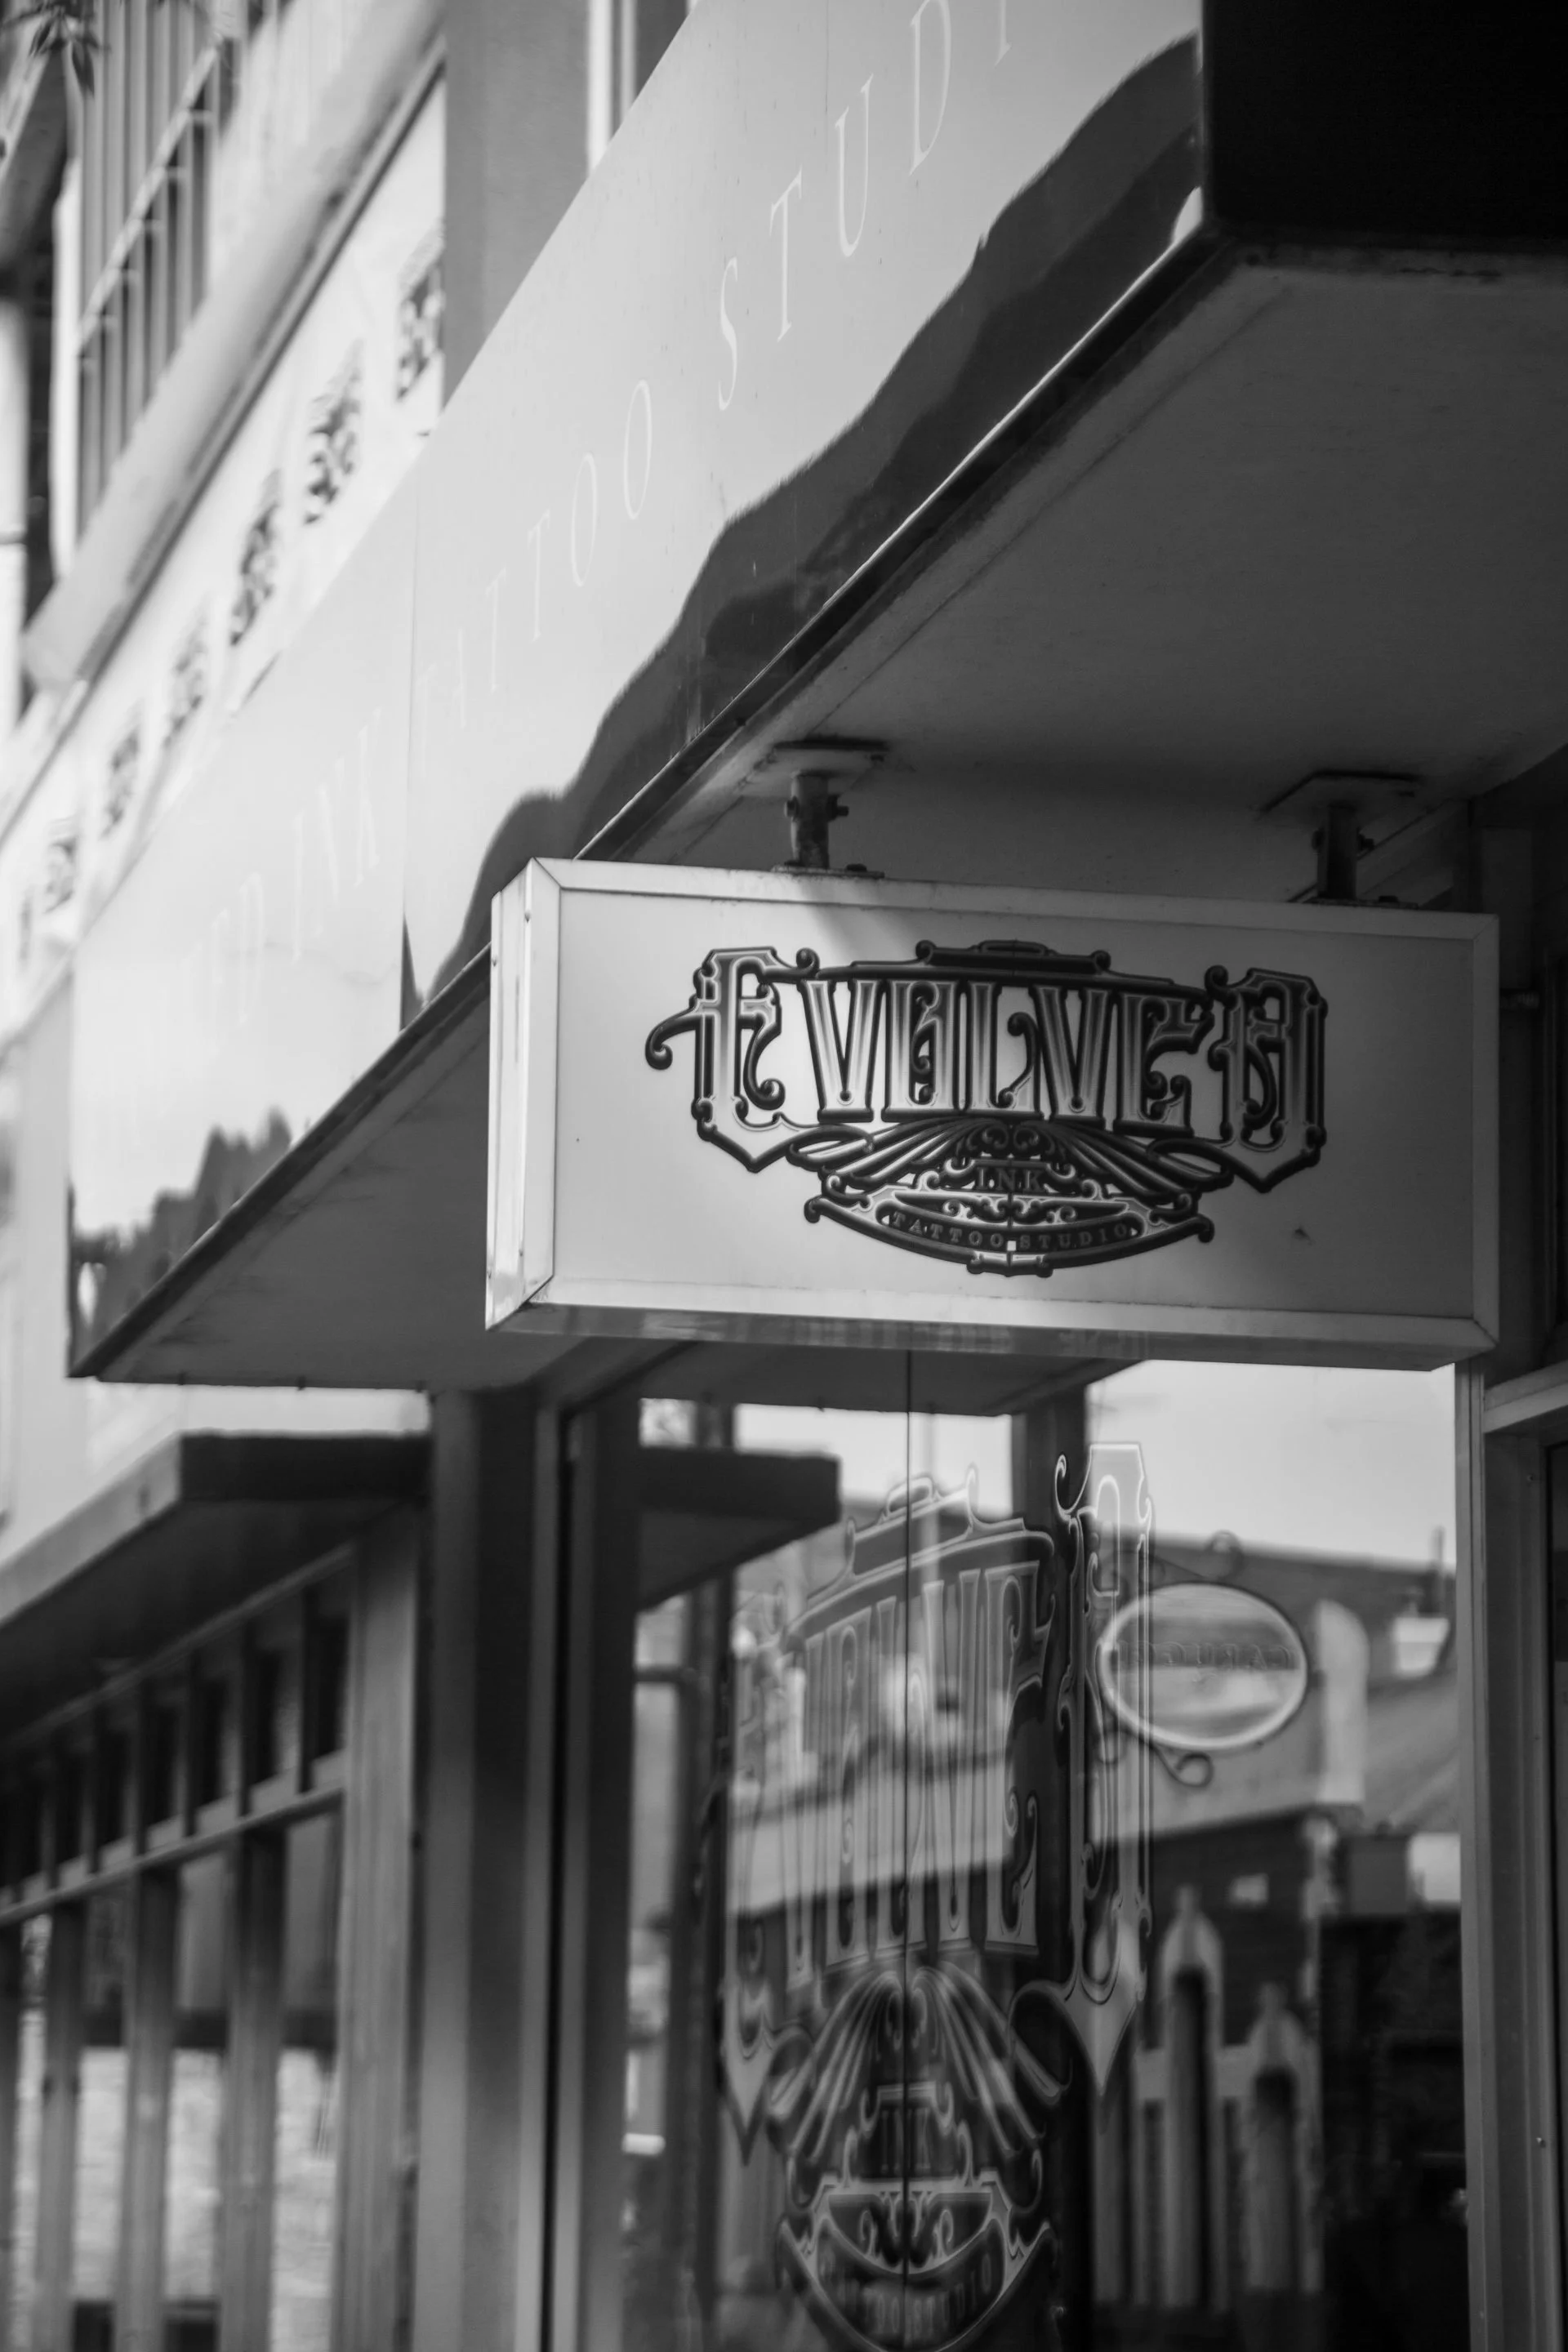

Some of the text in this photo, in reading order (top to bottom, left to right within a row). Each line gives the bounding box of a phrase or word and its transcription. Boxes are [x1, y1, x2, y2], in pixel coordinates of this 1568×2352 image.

[644, 945, 1327, 1193] EVOLVED
[974, 1165, 1045, 1193] INK
[890, 1210, 1129, 1250] TATTOO STUDIO
